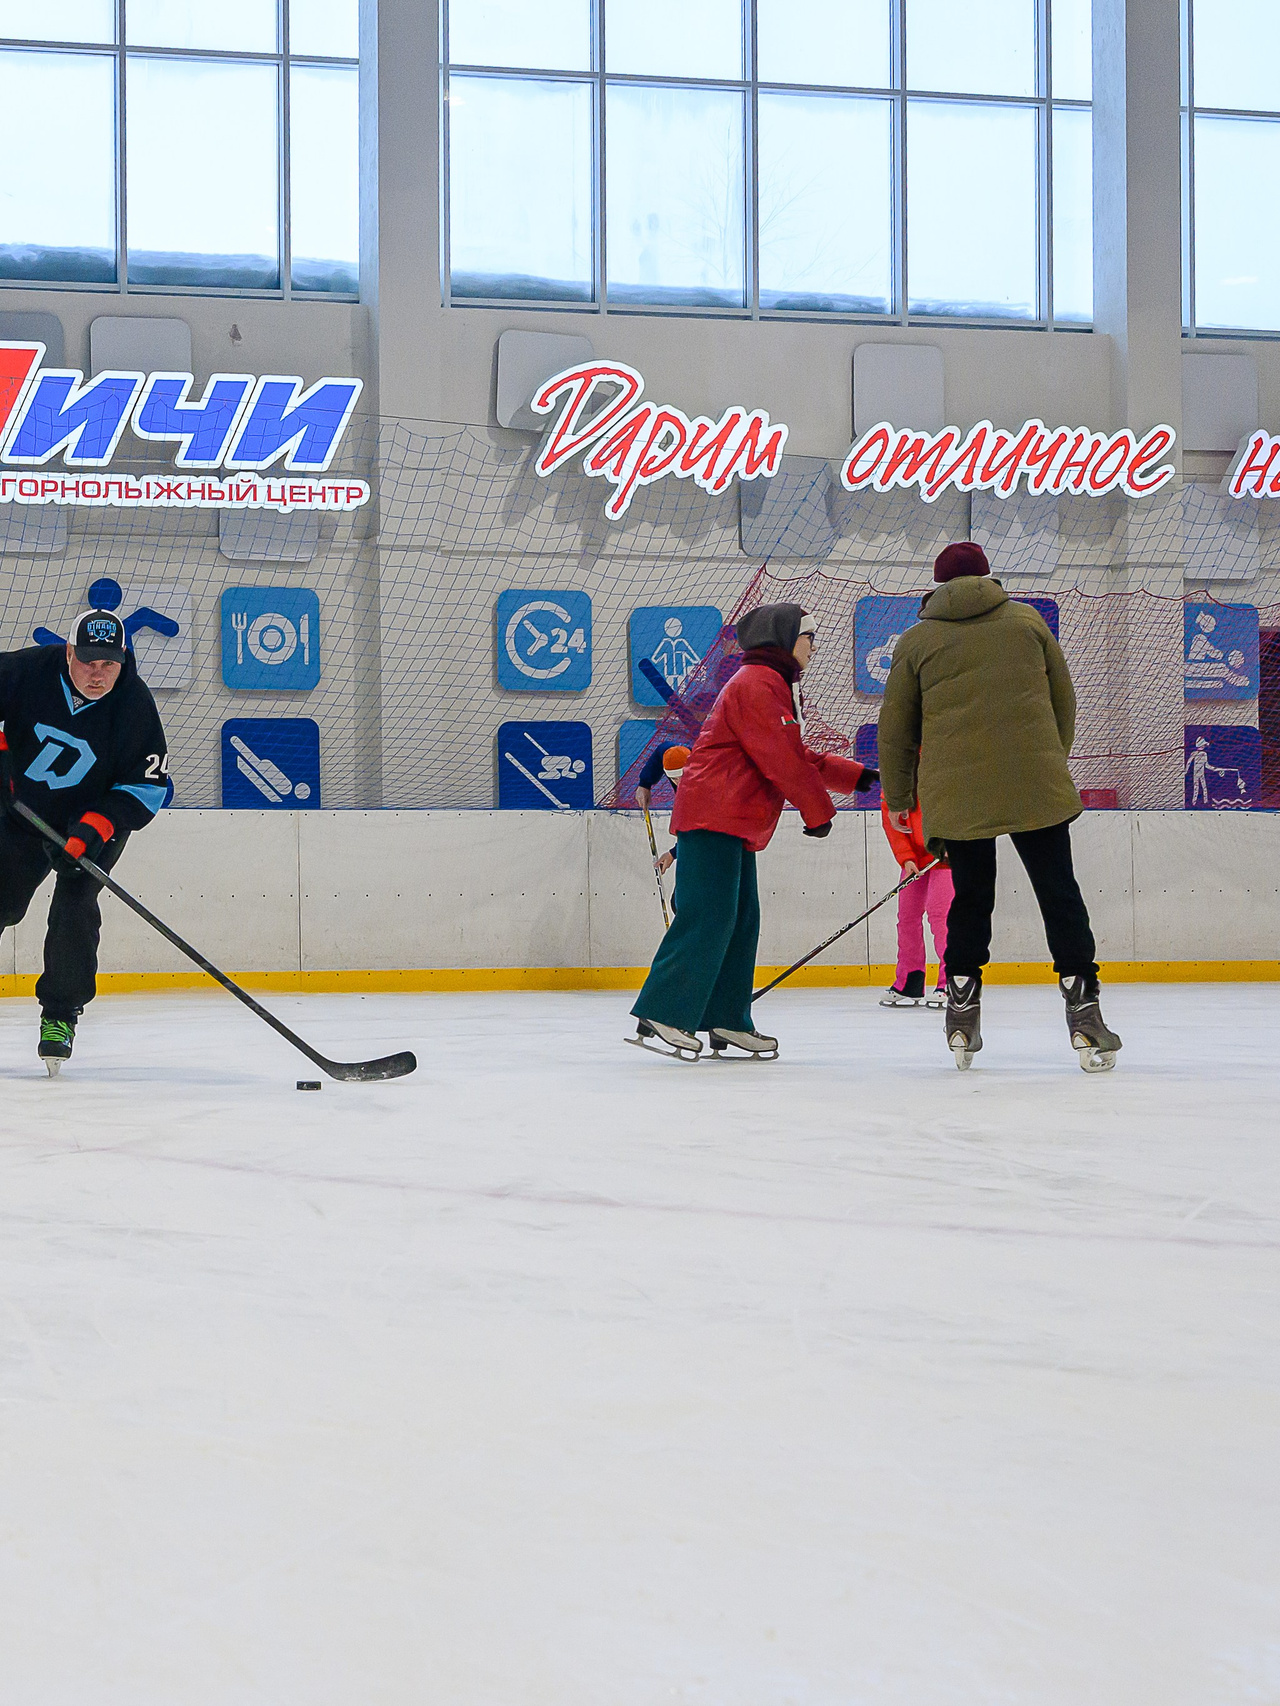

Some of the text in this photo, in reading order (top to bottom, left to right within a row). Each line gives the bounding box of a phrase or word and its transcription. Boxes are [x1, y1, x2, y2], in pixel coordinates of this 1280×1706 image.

[537, 366, 782, 514] Дарим
[846, 425, 1170, 497] отличное
[1, 478, 258, 502] ГОРНОЛЫЖНЫЙ
[267, 485, 364, 506] ЦЕНТР
[550, 627, 587, 653] 24
